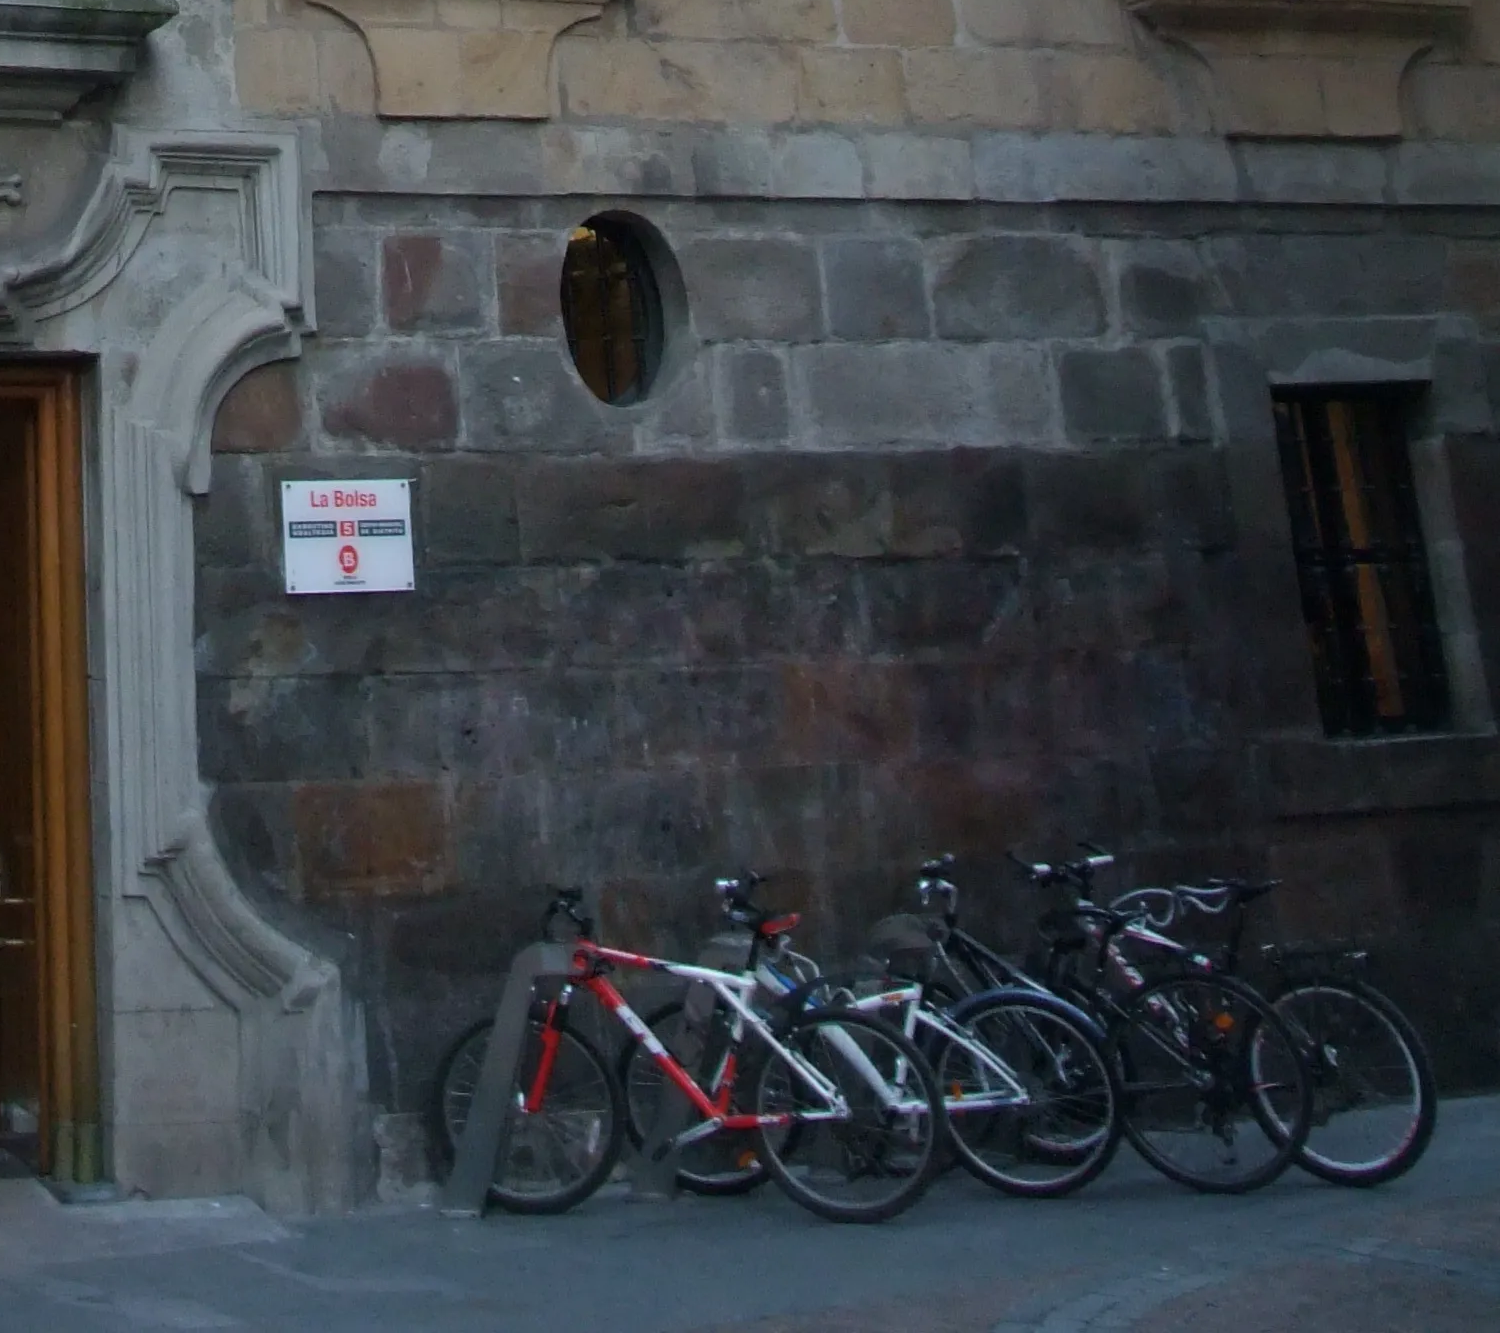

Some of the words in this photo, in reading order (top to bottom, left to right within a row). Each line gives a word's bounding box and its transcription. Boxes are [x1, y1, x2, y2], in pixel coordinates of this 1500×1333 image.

[310, 490, 329, 507] La
[334, 489, 377, 507] Bolsa
[342, 522, 353, 535] 5
